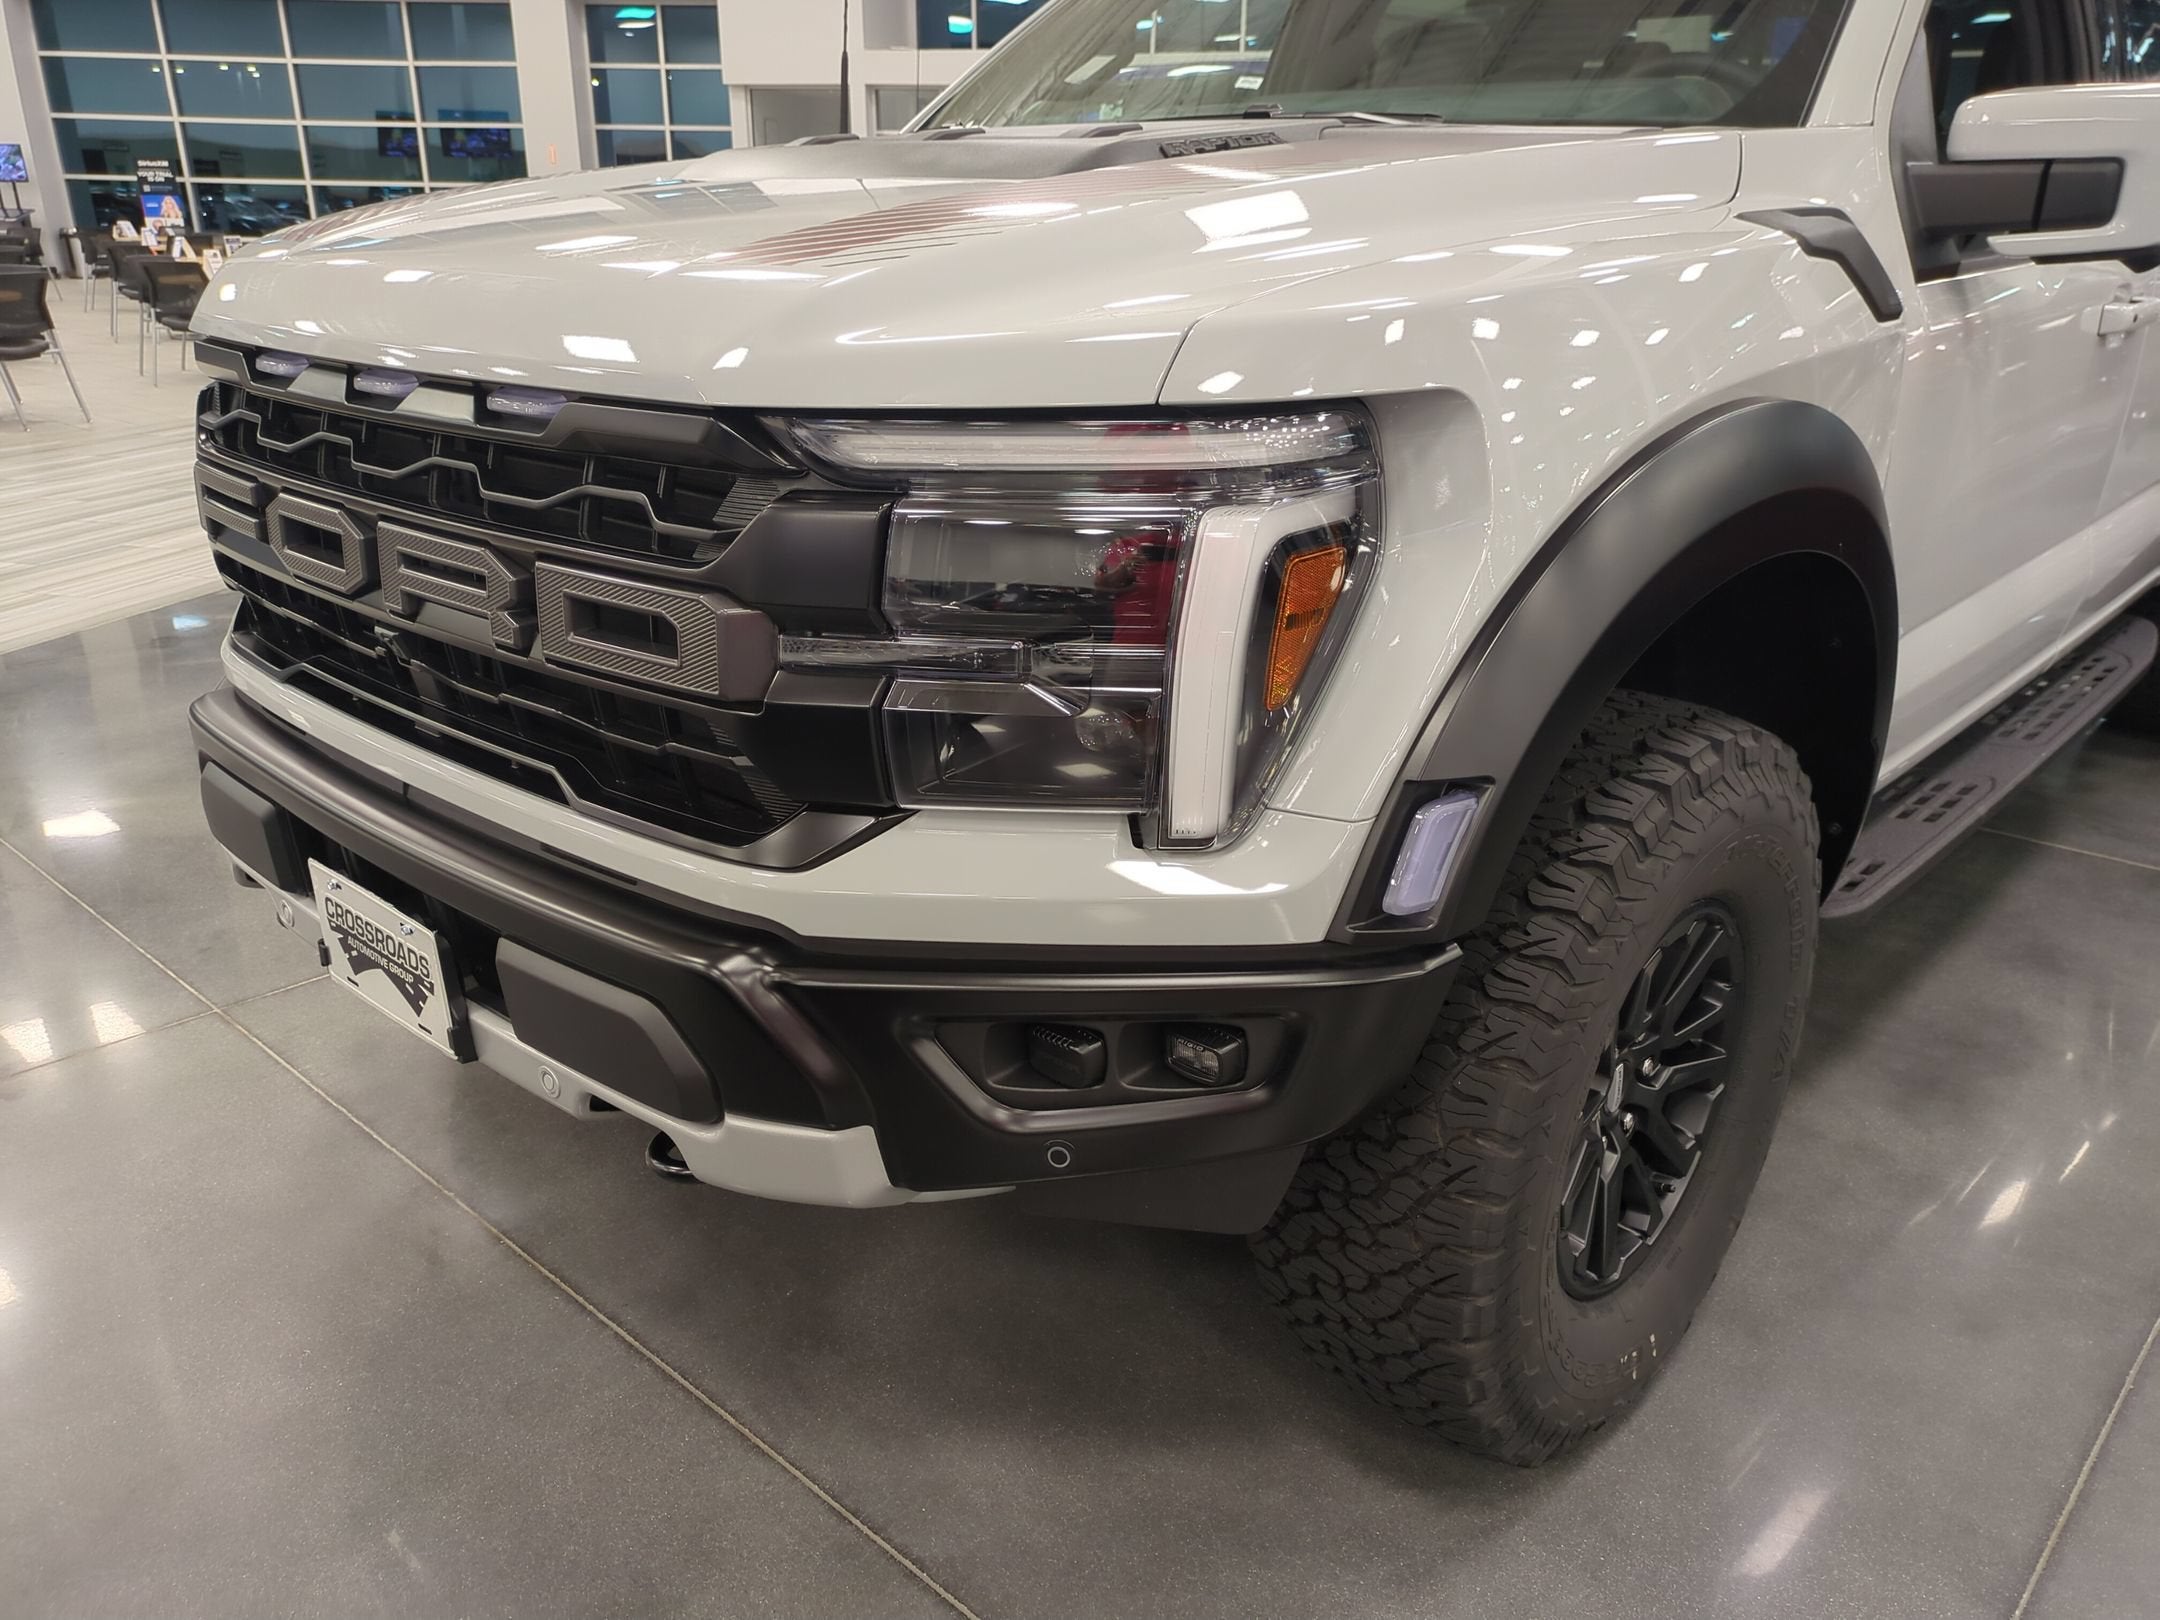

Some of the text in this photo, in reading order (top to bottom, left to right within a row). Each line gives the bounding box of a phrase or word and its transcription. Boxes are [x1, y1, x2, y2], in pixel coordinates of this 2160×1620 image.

[1162, 132, 1281, 158] RAPTOR
[194, 460, 720, 695] FORD
[325, 896, 430, 980] CROSSROADS
[347, 935, 415, 984] AUTOMOTIVE GROUP
